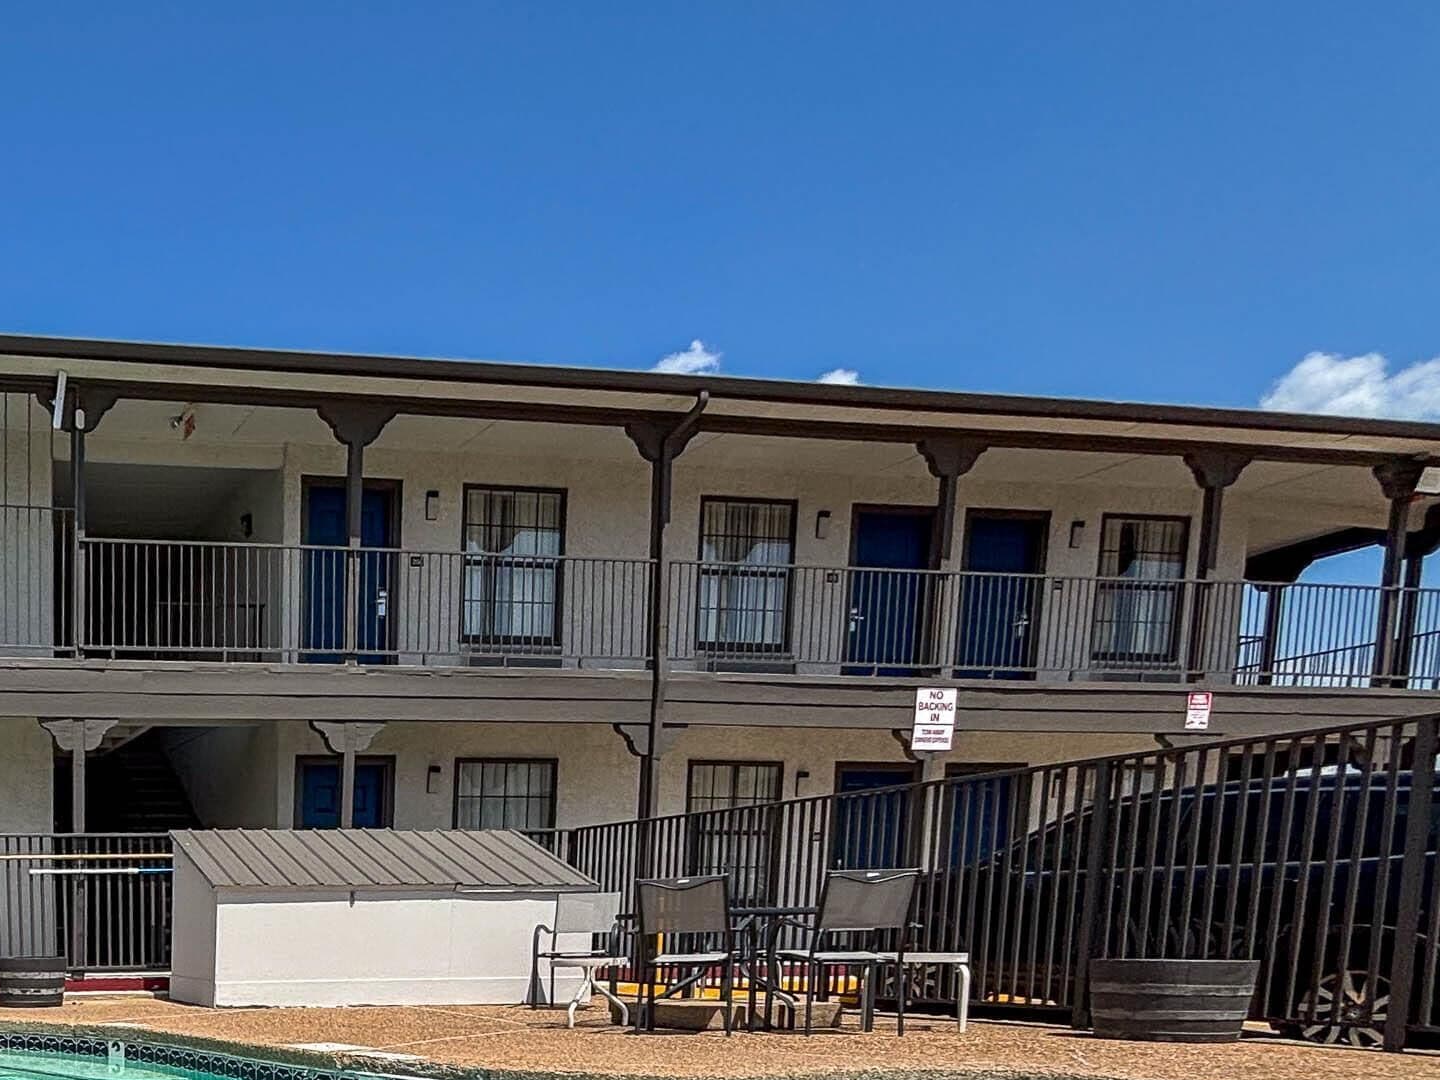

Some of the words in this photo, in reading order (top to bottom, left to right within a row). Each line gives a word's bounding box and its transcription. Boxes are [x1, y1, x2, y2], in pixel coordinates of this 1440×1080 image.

[930, 691, 943, 700] NO
[918, 702, 953, 711] BACKING
[930, 713, 940, 722] IN
